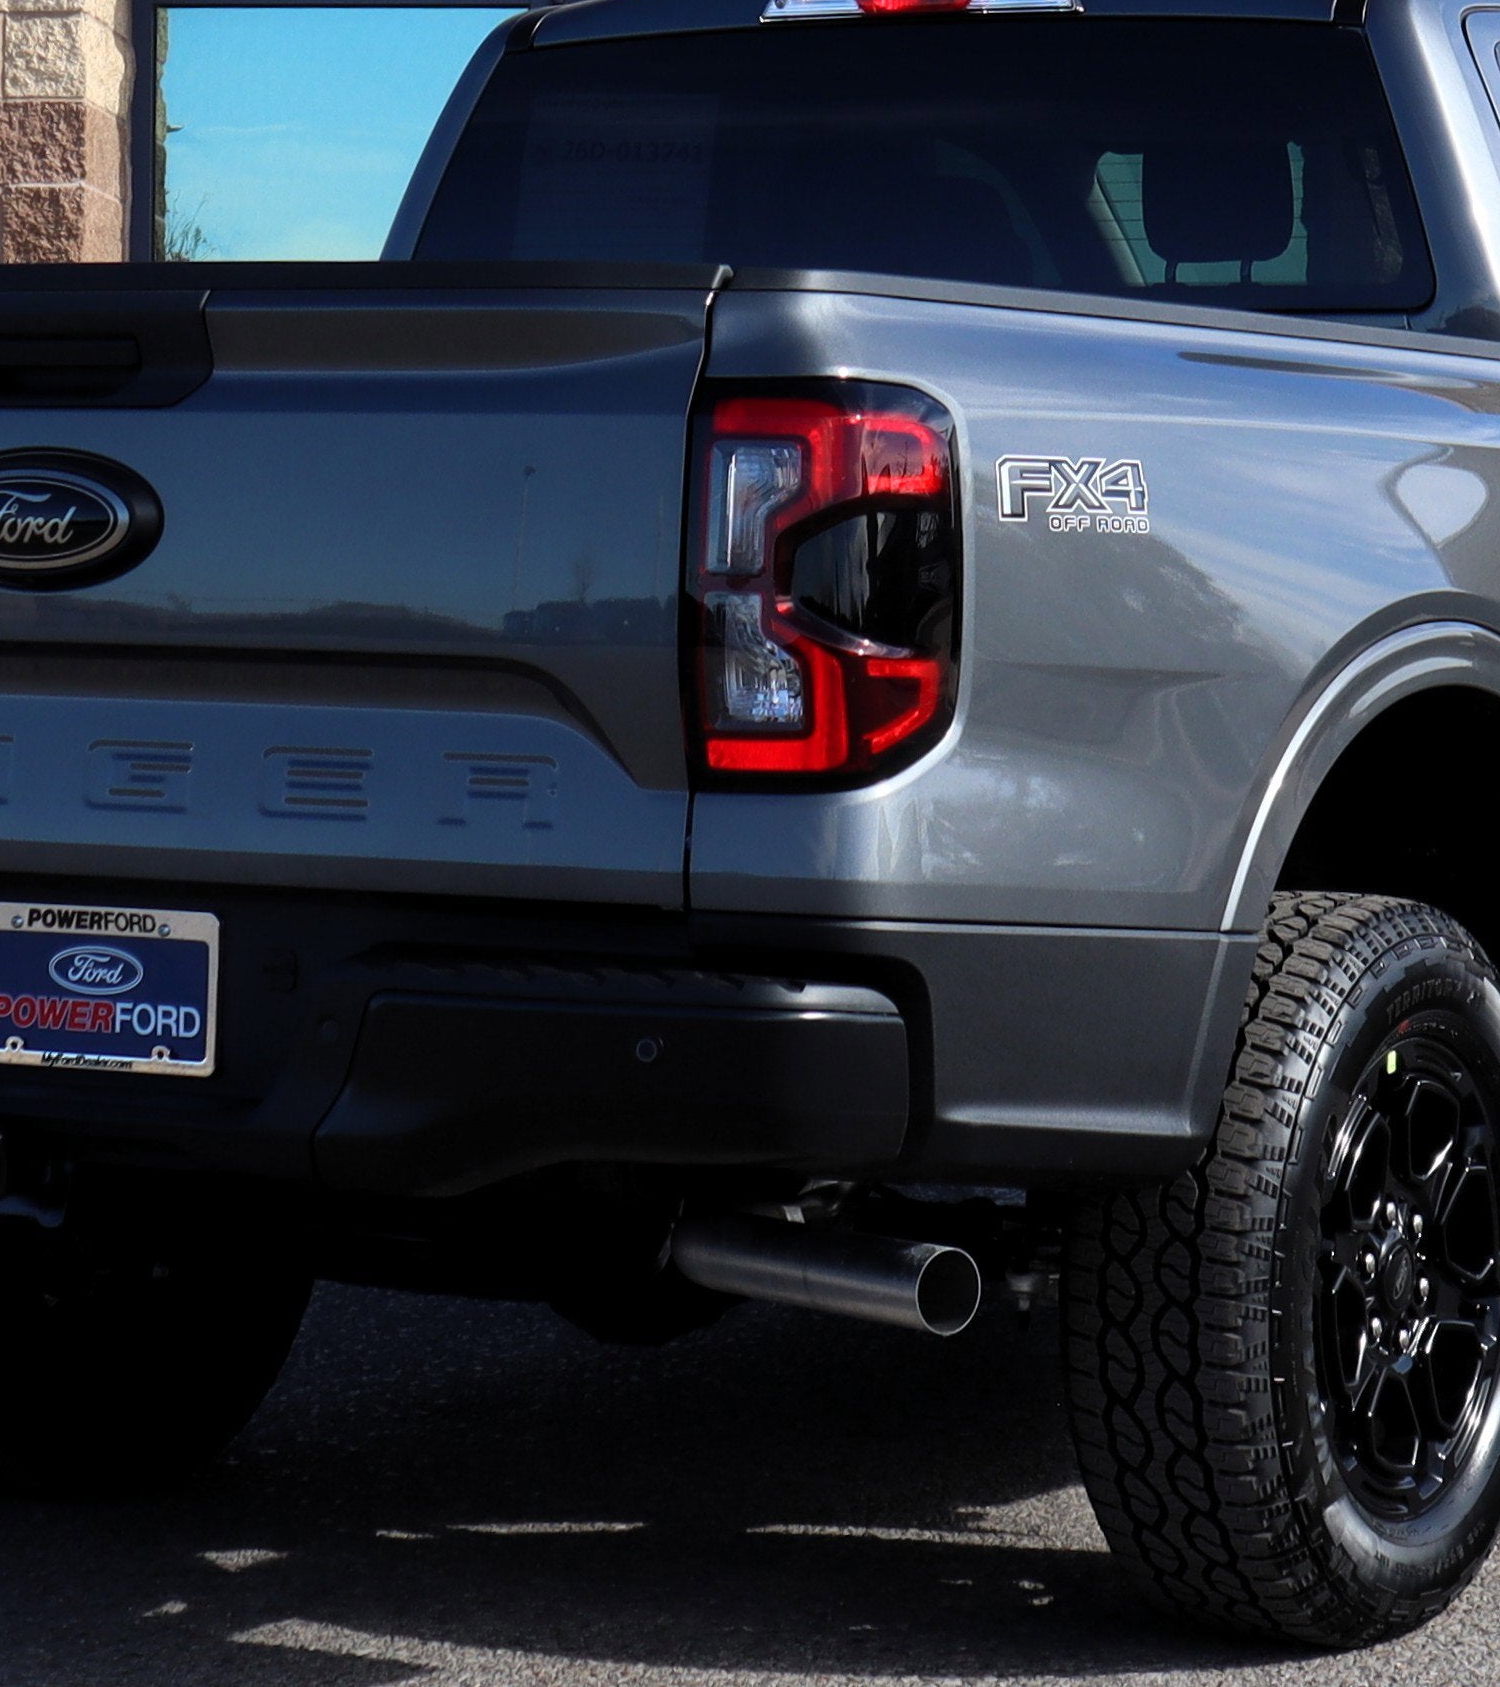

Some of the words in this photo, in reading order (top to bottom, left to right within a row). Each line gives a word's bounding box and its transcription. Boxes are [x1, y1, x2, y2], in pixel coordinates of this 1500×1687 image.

[996, 454, 1149, 522] FX4
[1049, 515, 1091, 532] OFF
[1096, 516, 1150, 534] ROAD
[27, 908, 157, 934] POWERFORD
[67, 954, 124, 985] Ford
